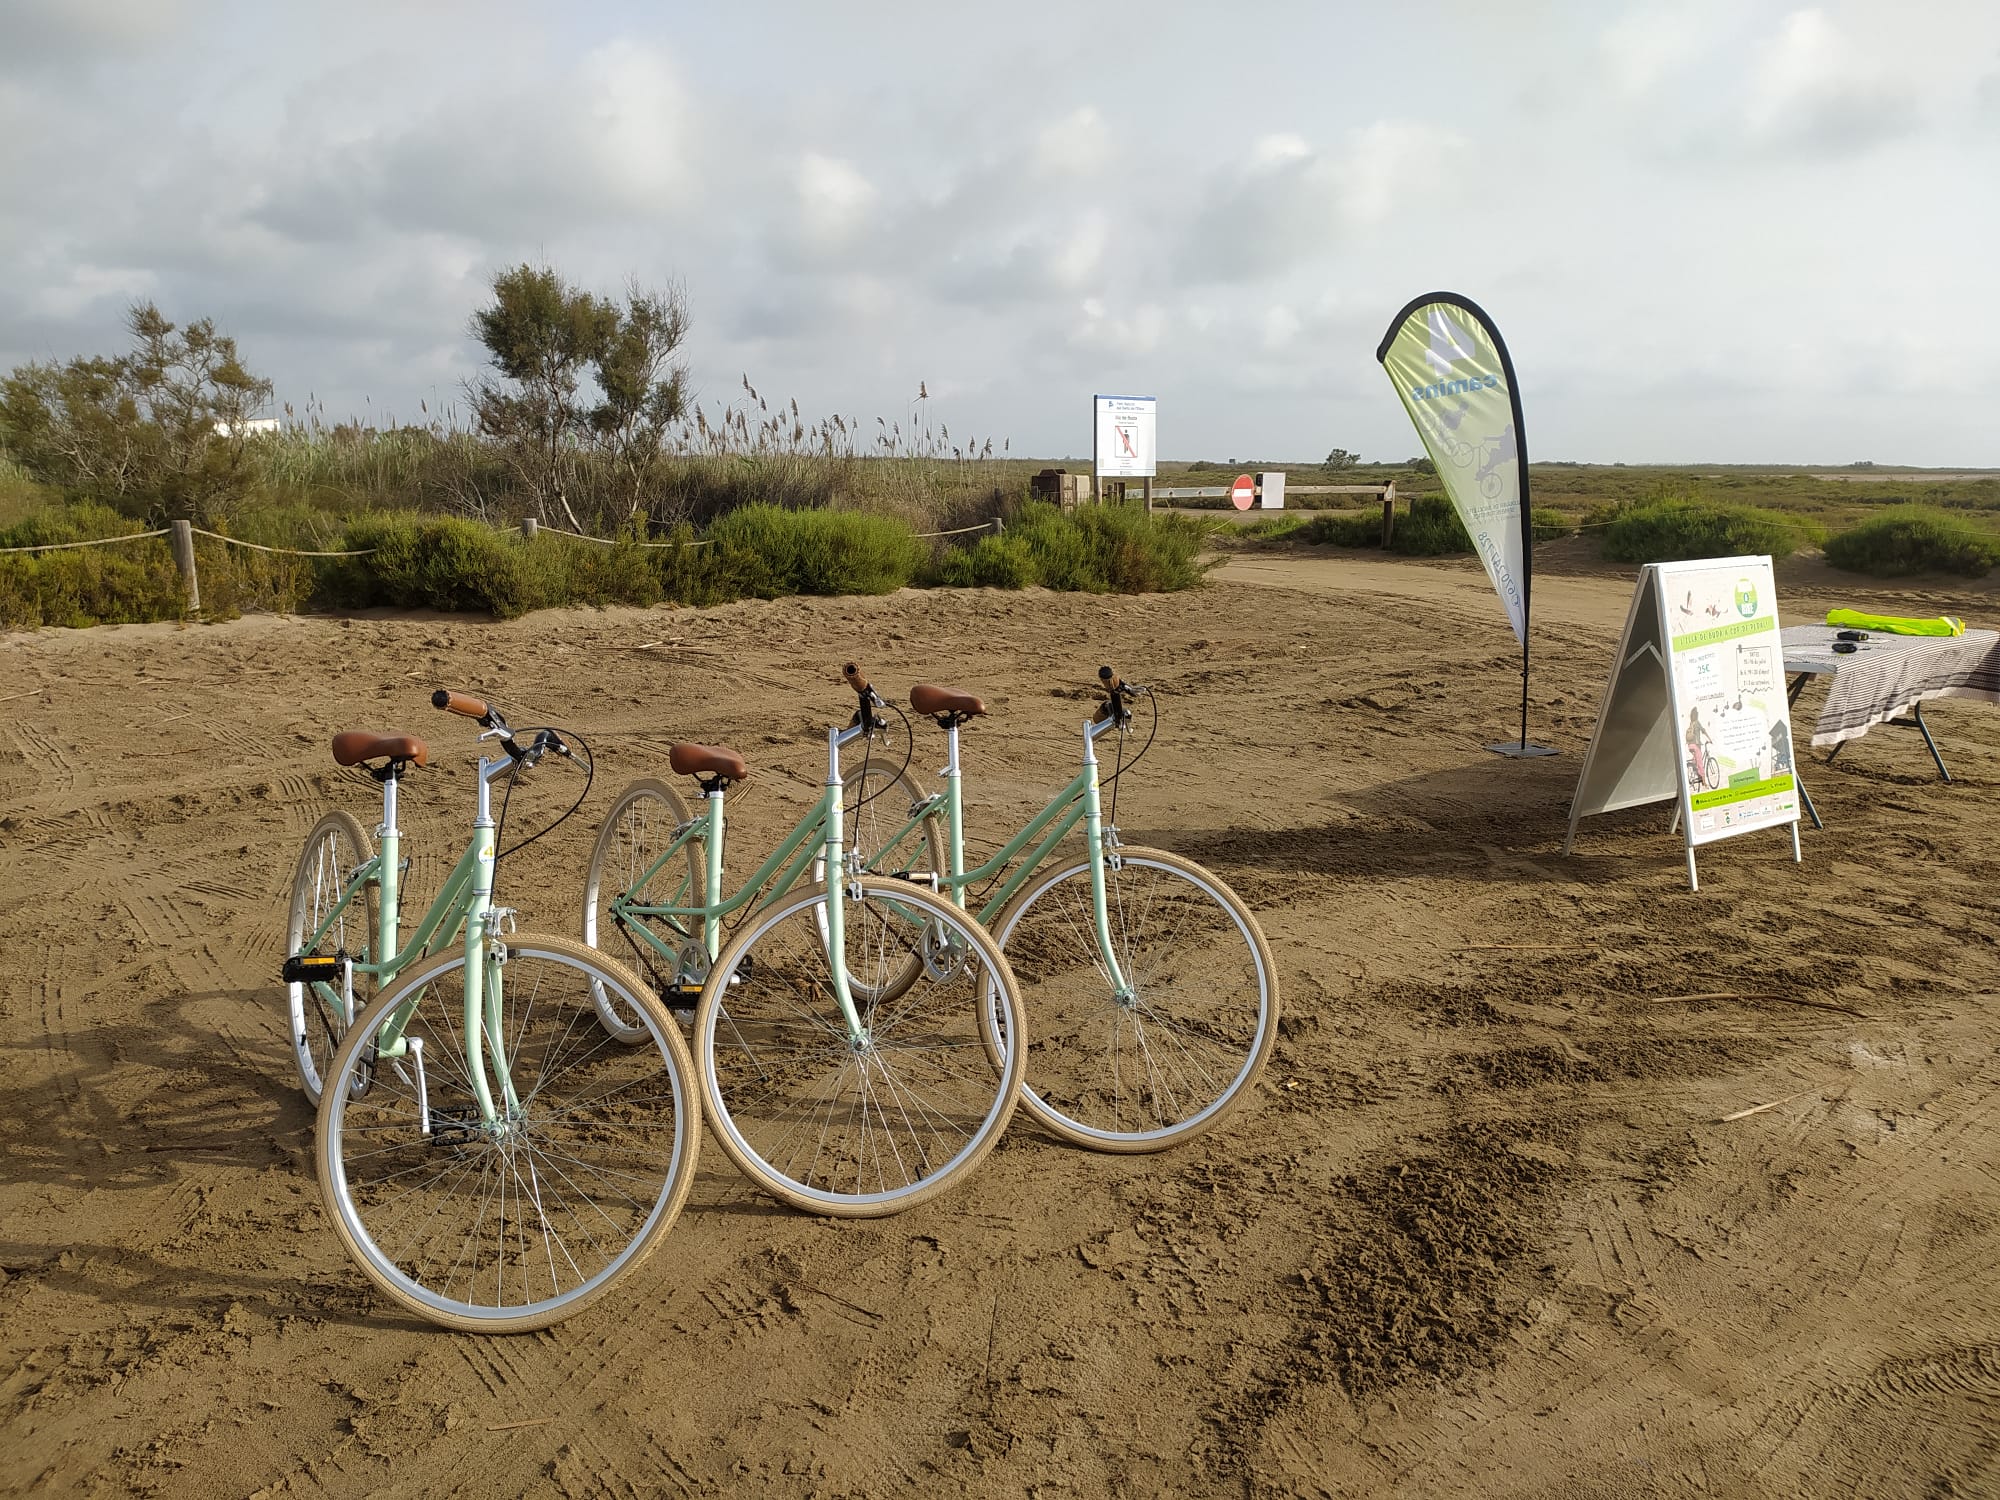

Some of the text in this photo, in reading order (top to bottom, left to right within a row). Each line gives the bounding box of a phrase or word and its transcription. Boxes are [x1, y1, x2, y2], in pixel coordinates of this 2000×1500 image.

[1700, 633, 1707, 641] DE
[1698, 664, 1711, 675] 25€
[484, 846, 493, 857] 4
